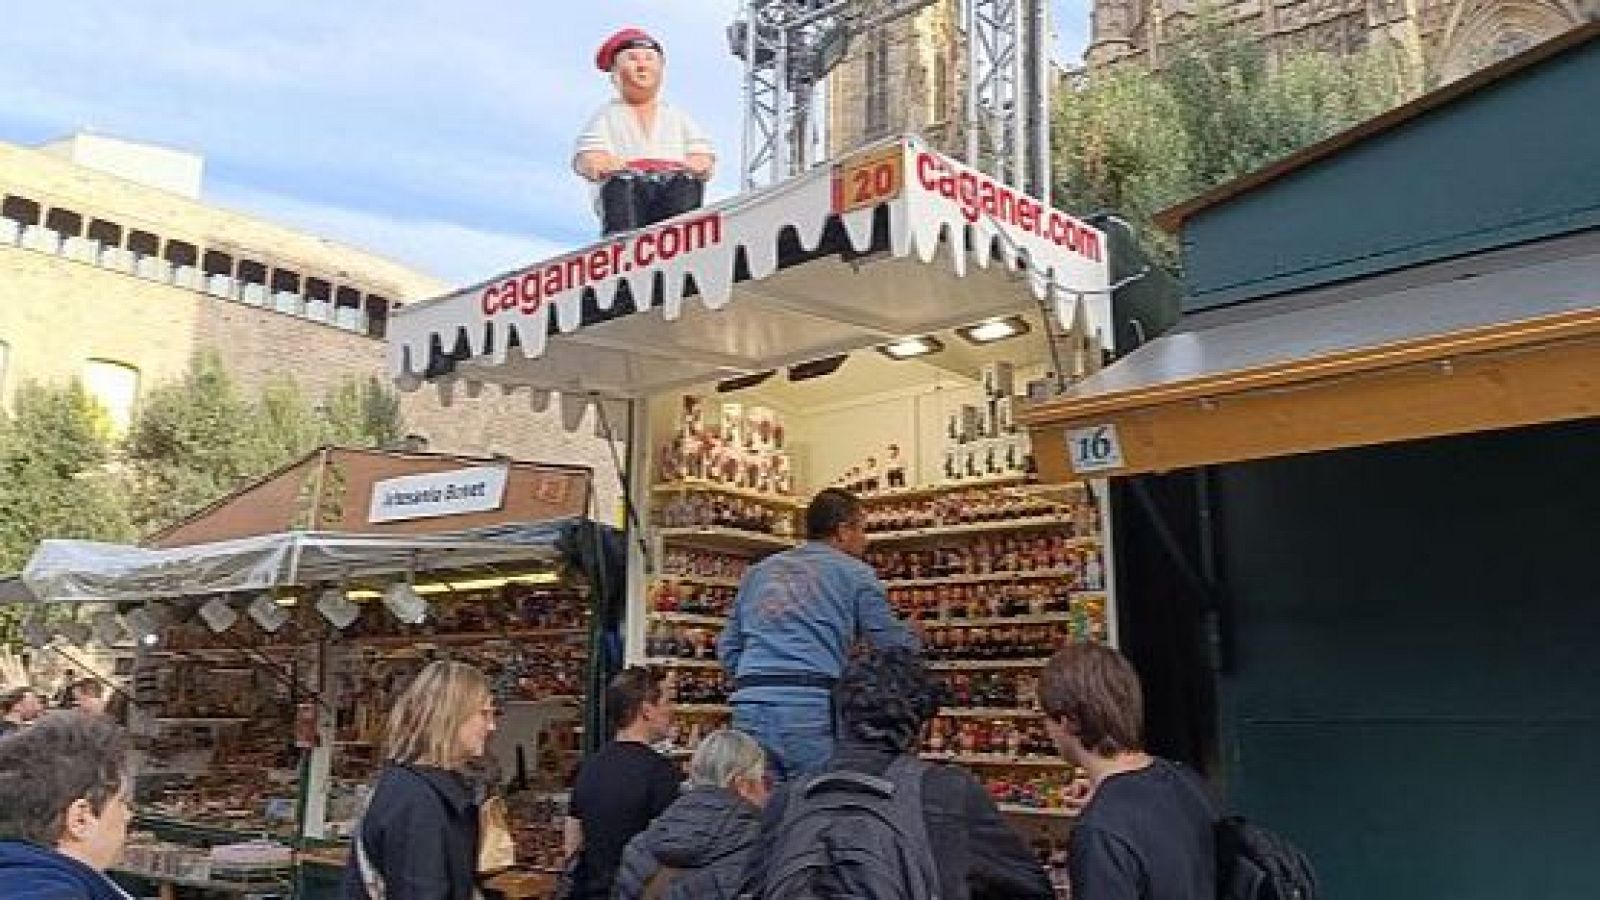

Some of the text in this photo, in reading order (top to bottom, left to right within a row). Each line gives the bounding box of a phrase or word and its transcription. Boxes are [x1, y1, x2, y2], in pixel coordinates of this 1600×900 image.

[852, 164, 892, 204] 20
[916, 151, 1102, 263] caganer.com
[482, 211, 721, 315] caganer.com
[1076, 426, 1111, 462] 16
